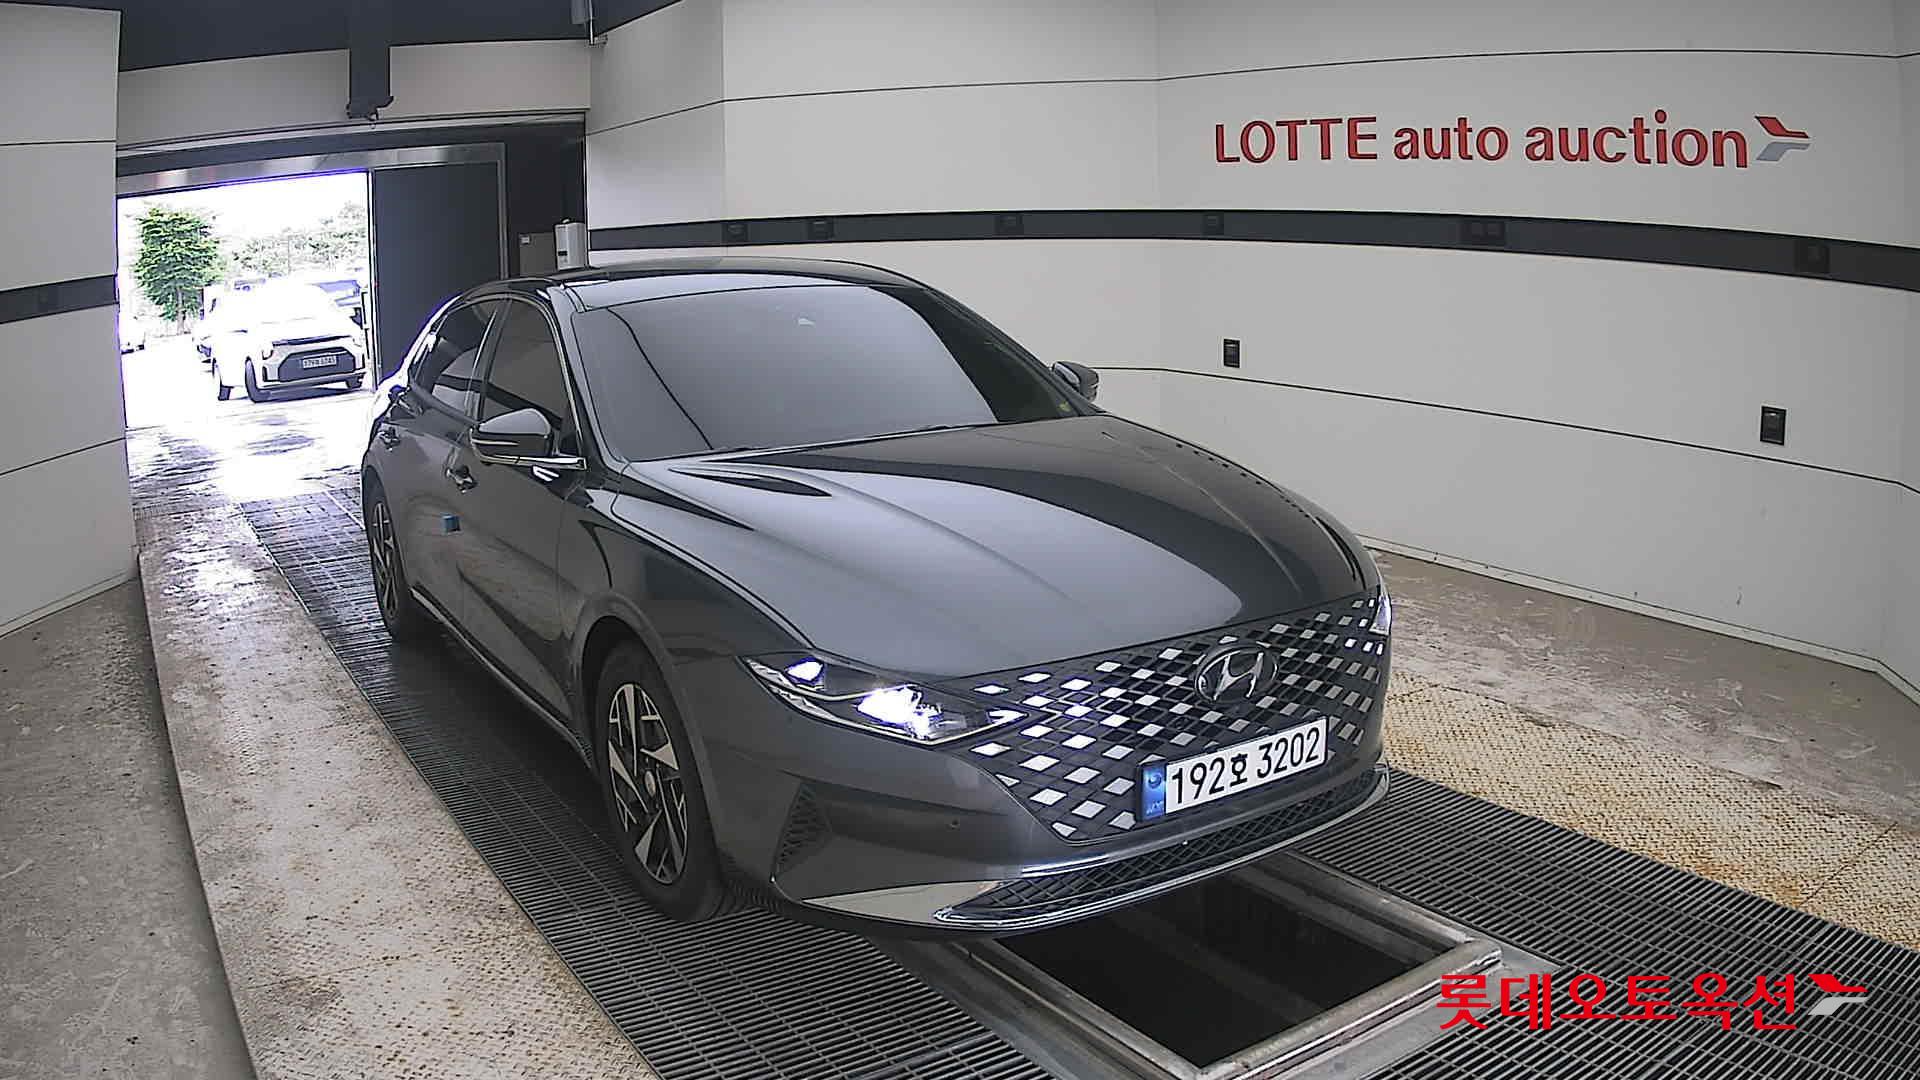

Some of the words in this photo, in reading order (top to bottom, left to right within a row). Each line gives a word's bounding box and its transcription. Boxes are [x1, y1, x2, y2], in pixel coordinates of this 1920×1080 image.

[1215, 116, 1378, 163] LOTTE
[1393, 117, 1510, 161] auto
[1524, 109, 1748, 168] auction
[1172, 753, 1248, 804] 192호
[1257, 727, 1320, 779] 3202
